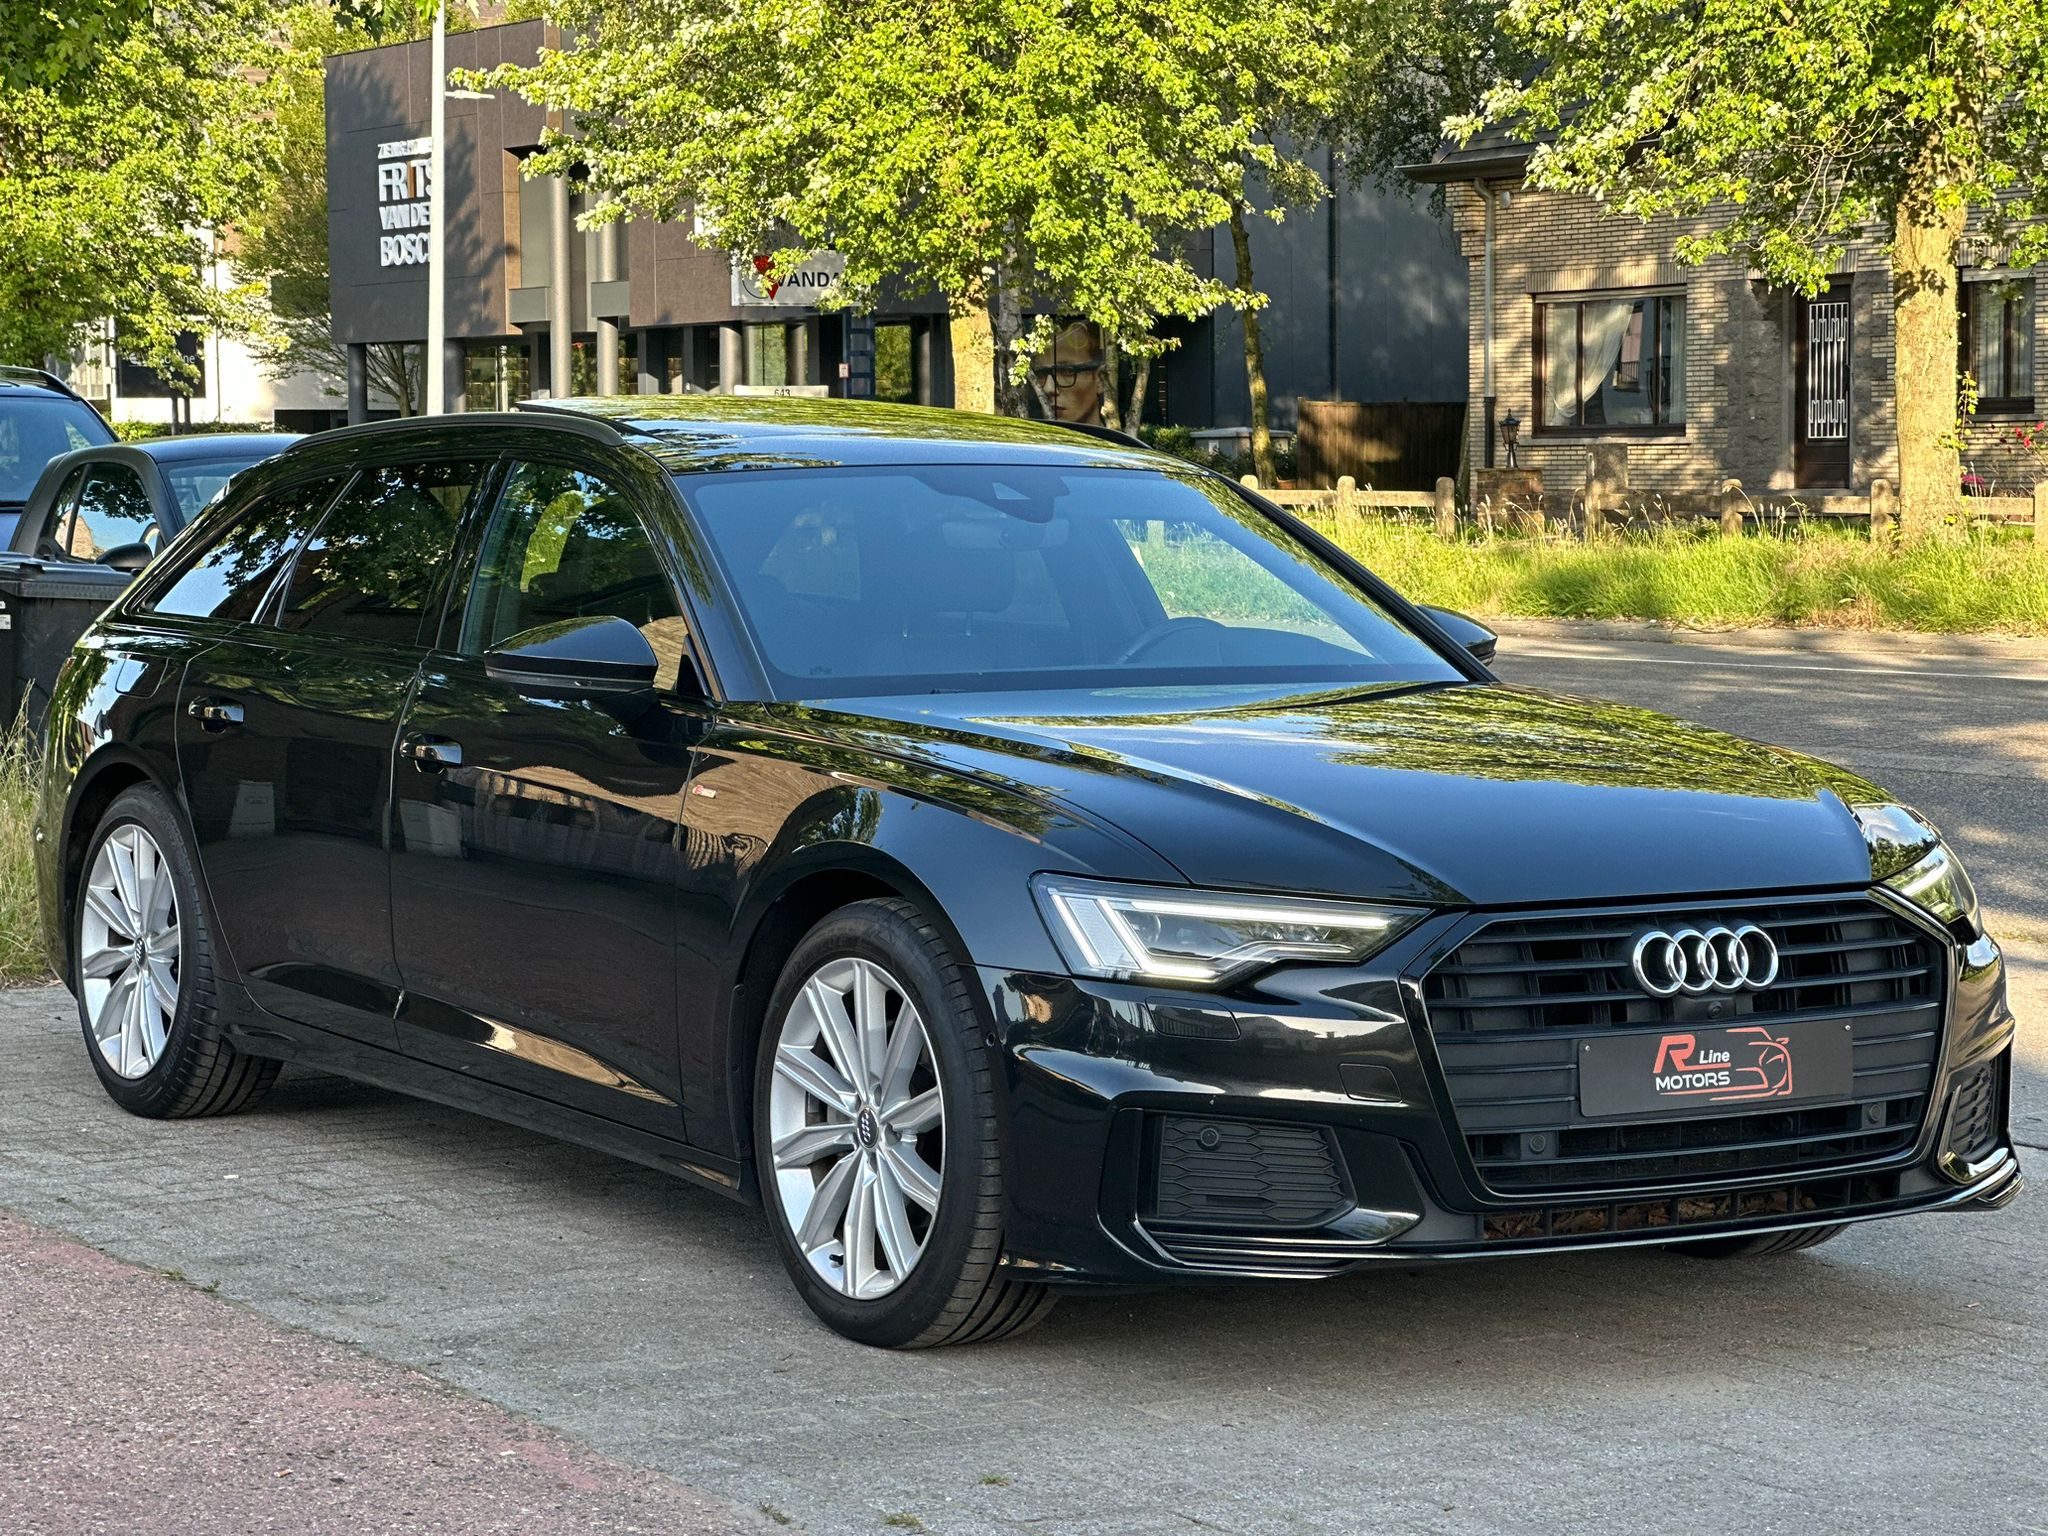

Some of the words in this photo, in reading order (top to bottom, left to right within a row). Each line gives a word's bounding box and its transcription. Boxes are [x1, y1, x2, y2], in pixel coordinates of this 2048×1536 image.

[379, 204, 410, 230] VAN
[380, 232, 431, 266] BOSC
[1652, 1034, 1696, 1074] R
[1699, 1049, 1730, 1064] Line
[1655, 1071, 1731, 1091] MOTORS
